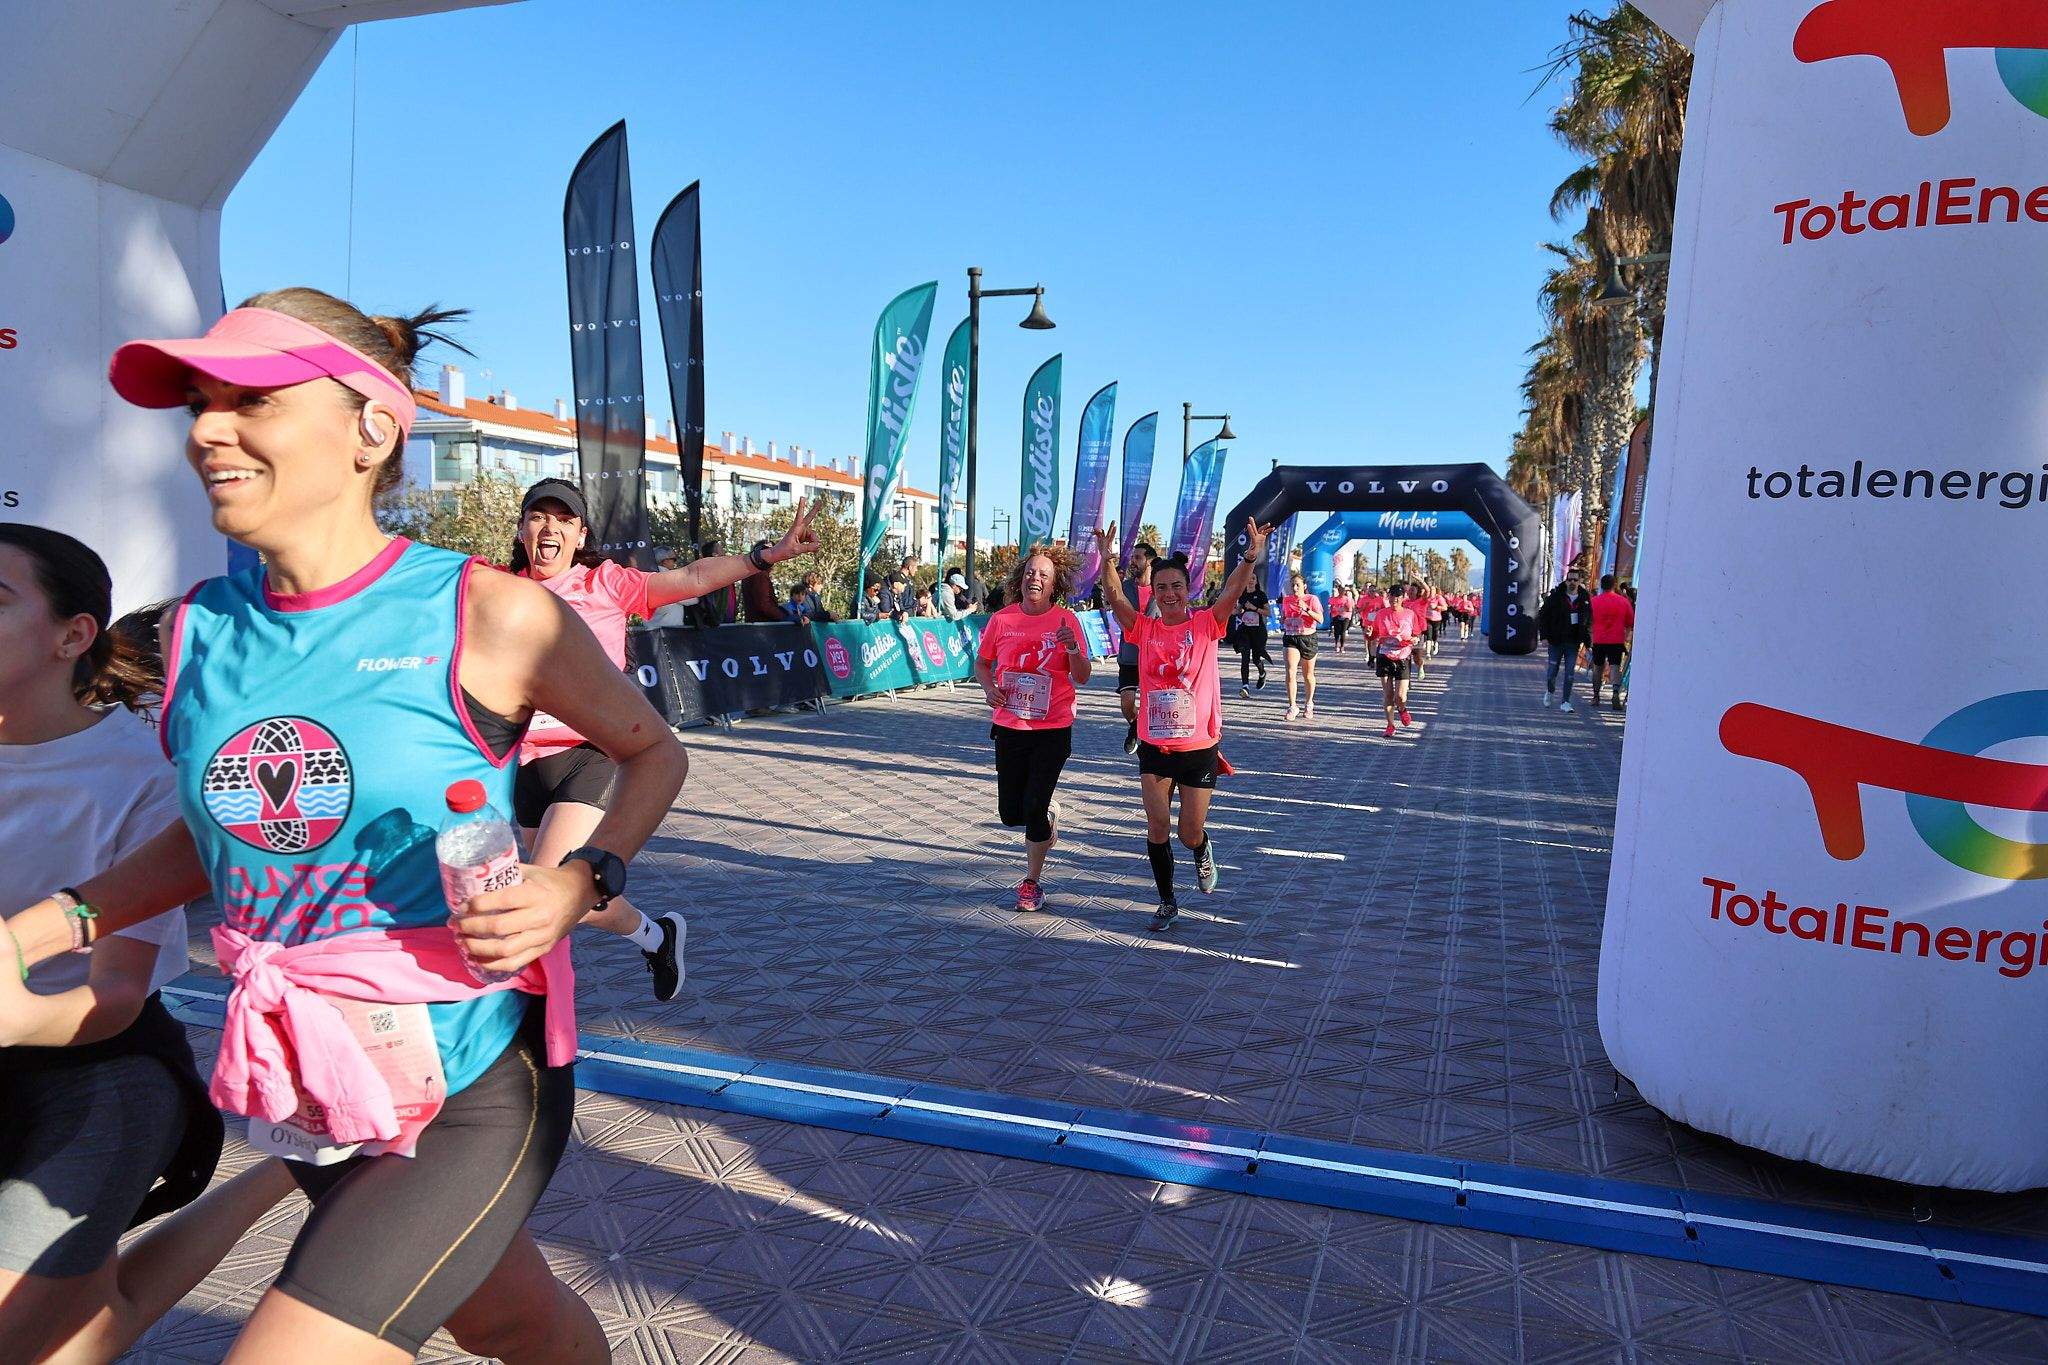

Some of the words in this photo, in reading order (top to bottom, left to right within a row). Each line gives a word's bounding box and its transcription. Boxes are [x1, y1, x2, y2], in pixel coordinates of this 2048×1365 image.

[568, 241, 630, 256] VOLO
[578, 394, 643, 406] VOLVO
[1023, 395, 1054, 538] Batiste
[1306, 479, 1449, 493] VOLVO
[1746, 459, 2048, 509] totalenergi
[602, 540, 647, 550] OLVO
[1507, 536, 1520, 640] VOLVO
[356, 656, 421, 672] FLOWER
[686, 648, 818, 682] VOLVO
[1160, 710, 1179, 720] 016
[1702, 876, 2048, 979] TotalEnergi
